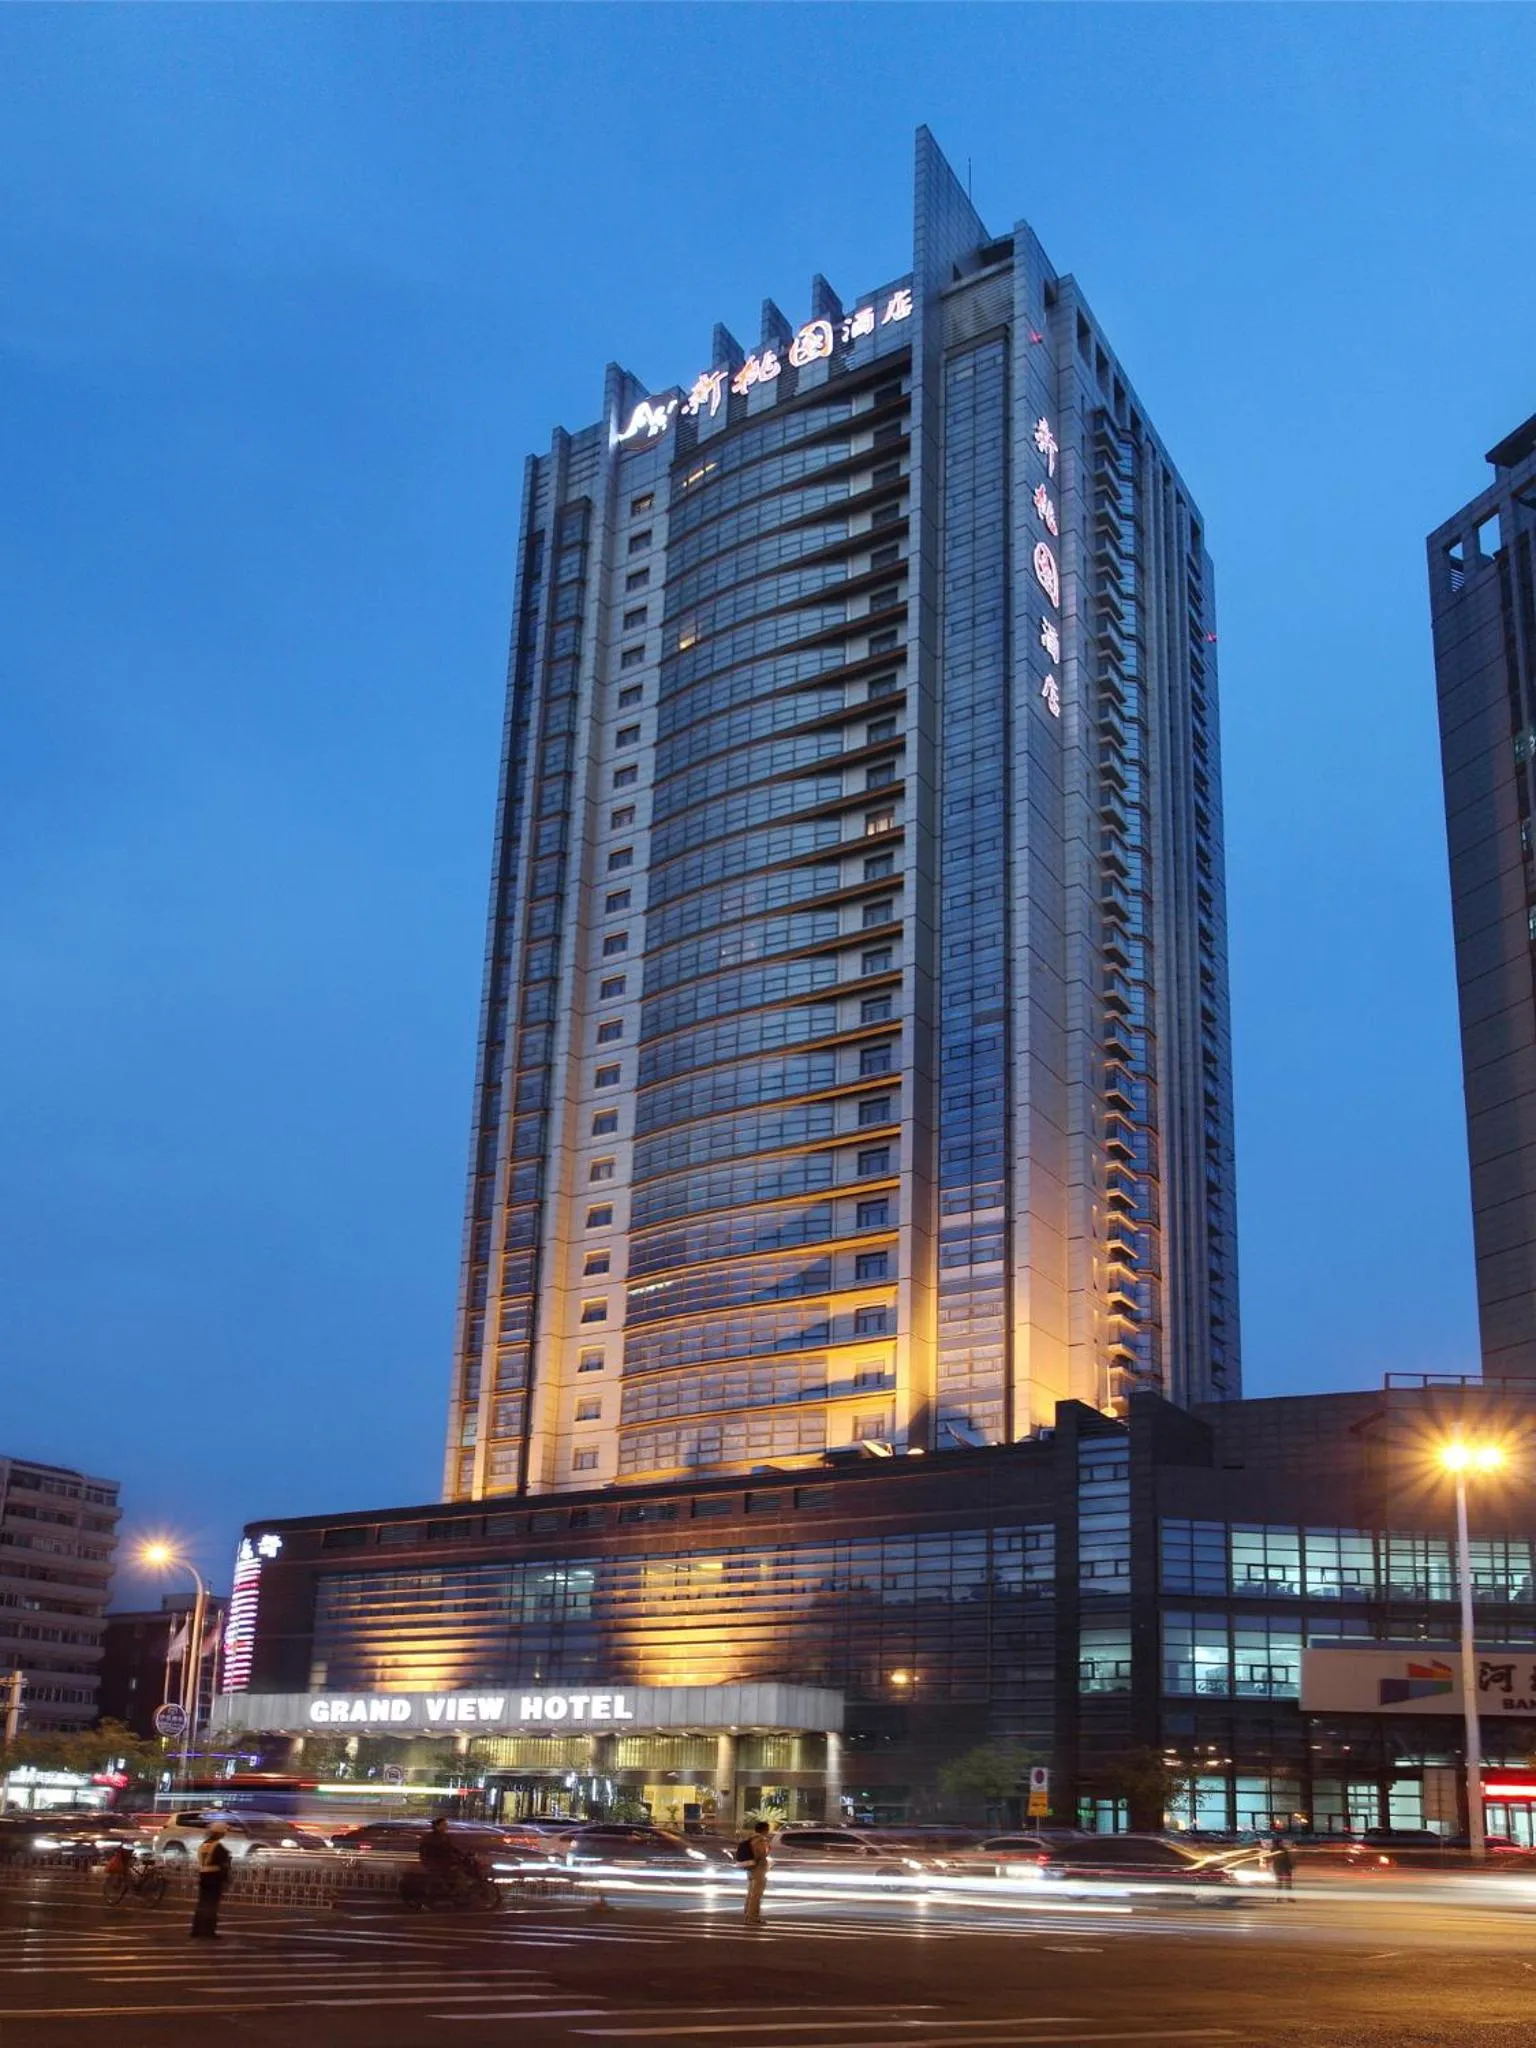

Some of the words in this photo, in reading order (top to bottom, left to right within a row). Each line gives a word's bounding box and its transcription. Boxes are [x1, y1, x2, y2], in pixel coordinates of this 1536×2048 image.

[309, 1699, 412, 1723] GRAND
[426, 1697, 505, 1721] VIEW
[520, 1695, 633, 1720] HOTEL
